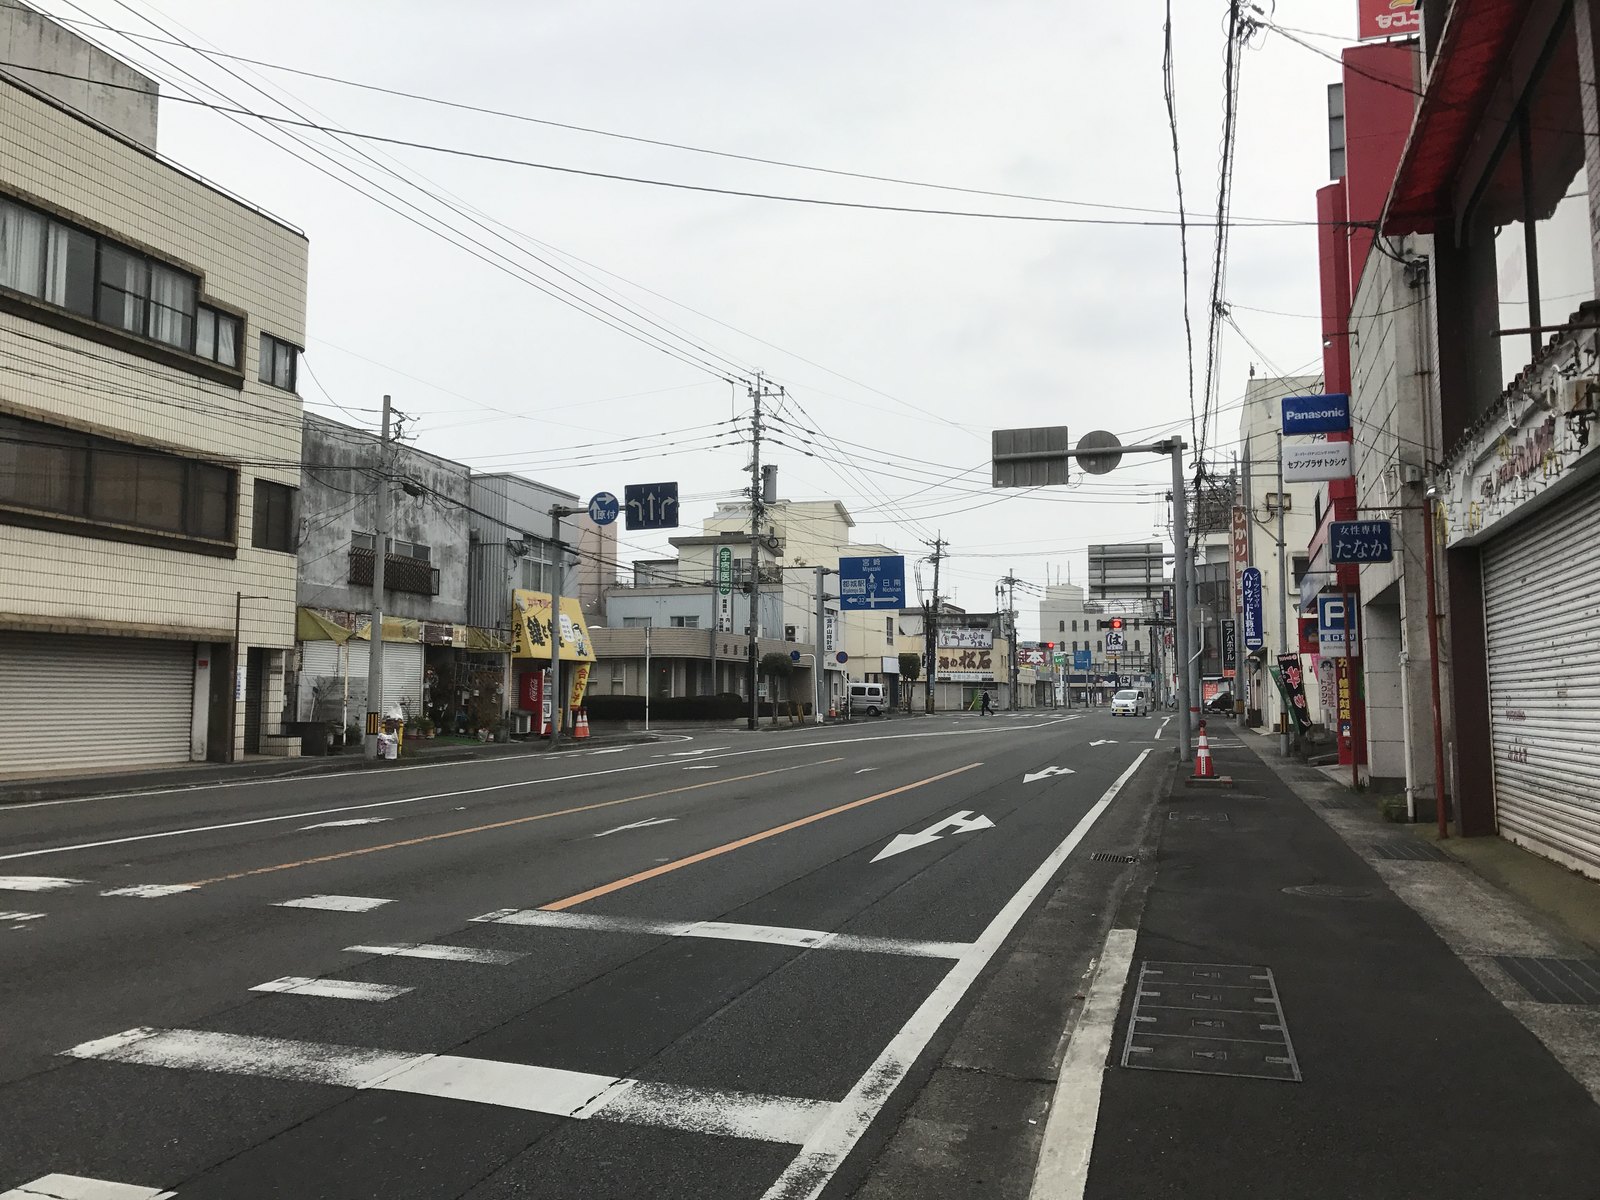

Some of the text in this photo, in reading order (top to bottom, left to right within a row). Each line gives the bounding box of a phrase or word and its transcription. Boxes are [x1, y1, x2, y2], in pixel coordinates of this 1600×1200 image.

[1286, 407, 1345, 420] Panasonic
[597, 509, 616, 520] 原付
[1340, 525, 1381, 535] 女性専科
[1336, 539, 1388, 558] たなか
